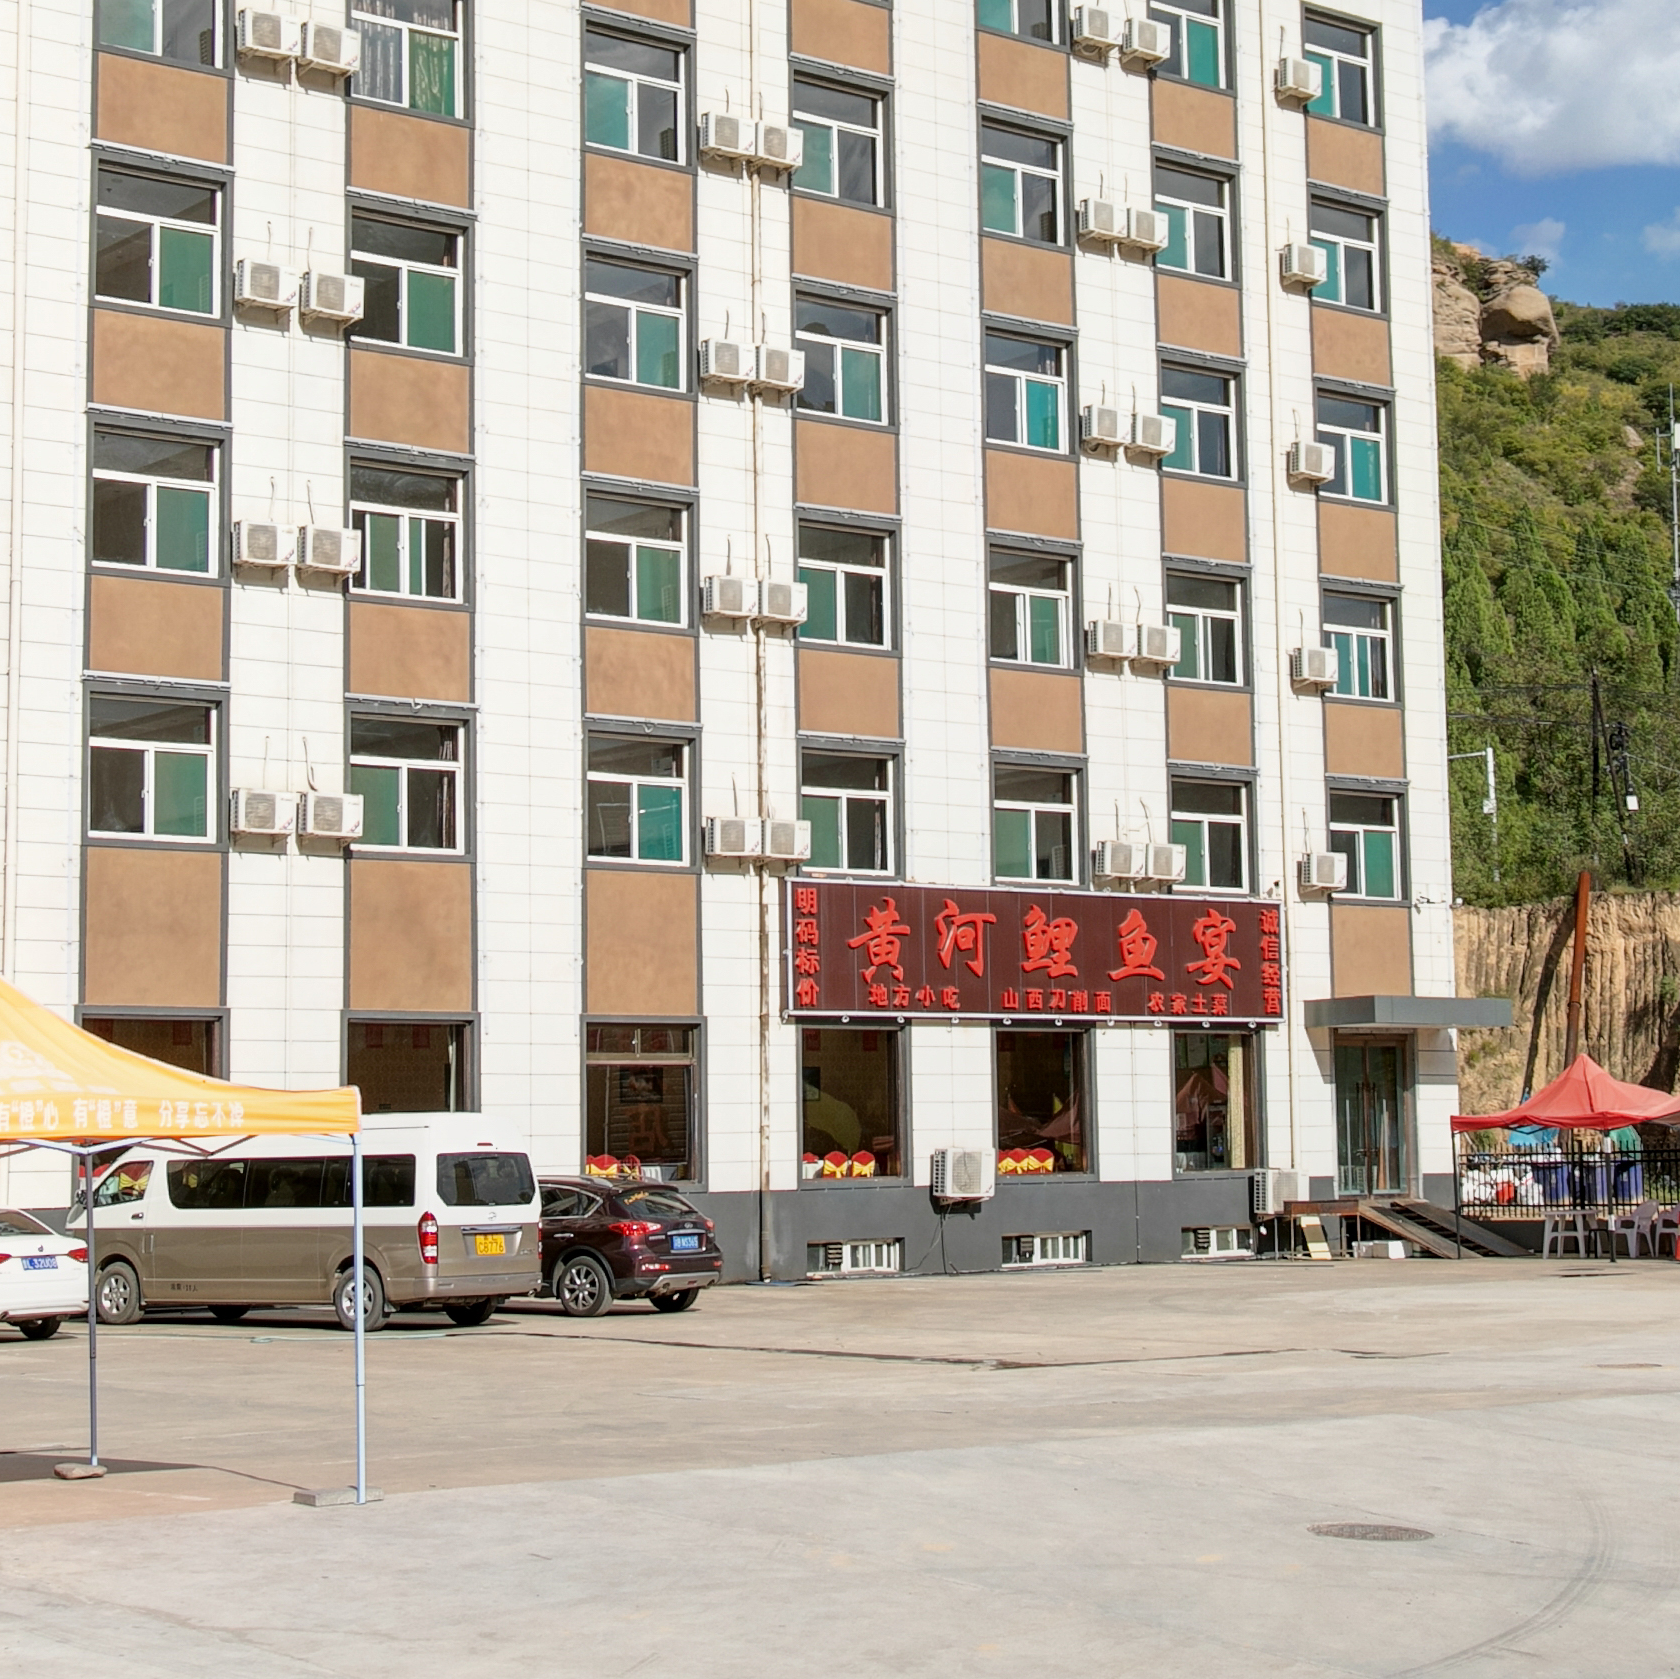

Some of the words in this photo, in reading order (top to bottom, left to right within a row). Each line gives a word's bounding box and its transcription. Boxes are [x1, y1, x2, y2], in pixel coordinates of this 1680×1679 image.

[795, 887, 820, 1007] 明码标价
[847, 896, 1242, 991] 黄河鲤鱼宴
[1258, 907, 1281, 1015] 诚信经营
[868, 983, 961, 1010] 地方小吃
[1001, 986, 1112, 1014] 山西刀削面
[1147, 991, 1229, 1016] 农家土菜
